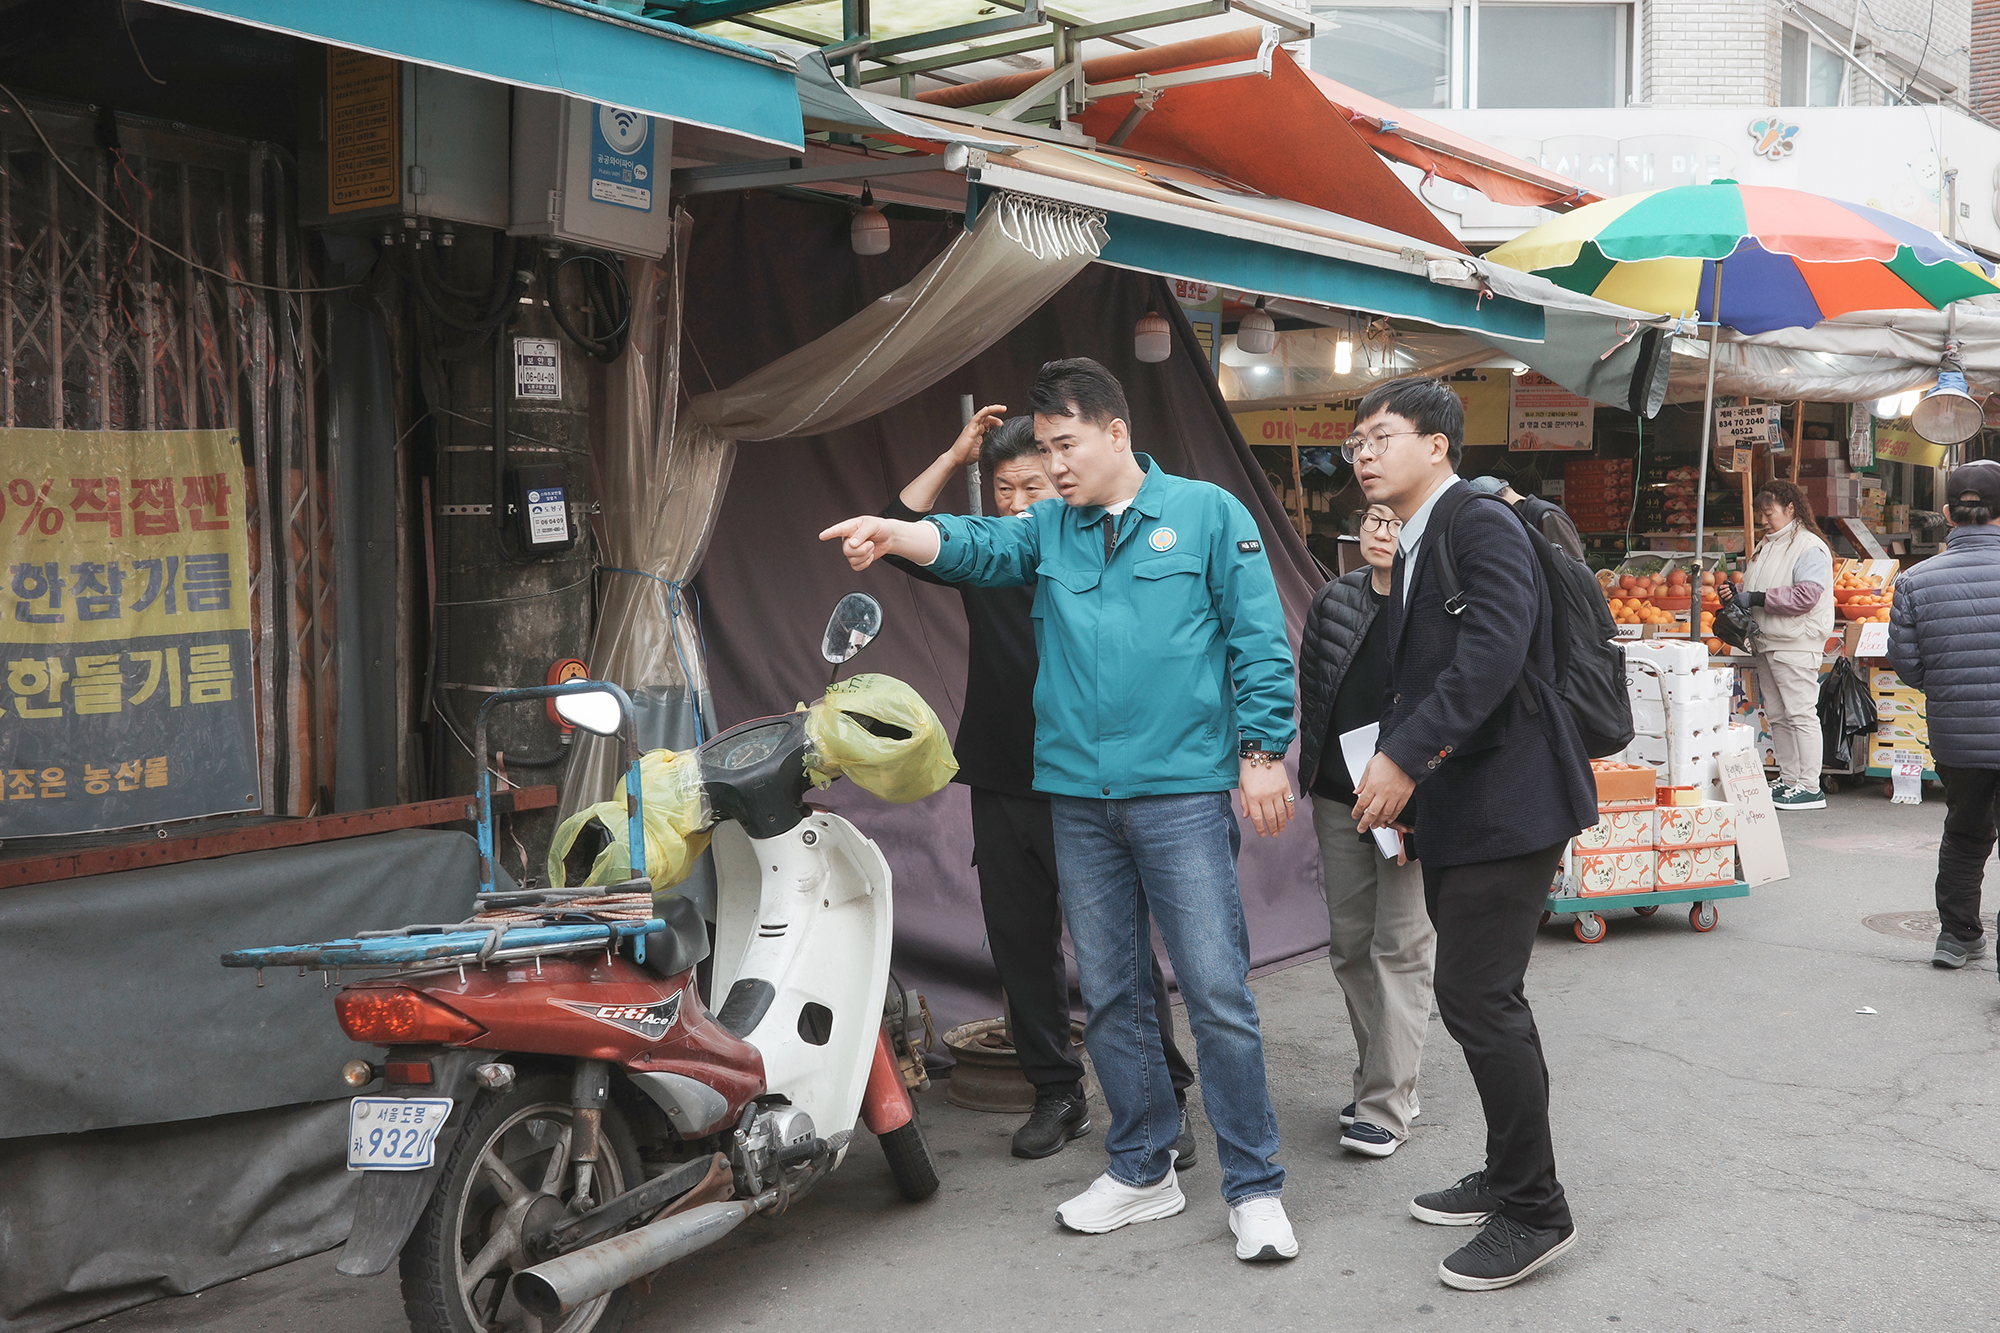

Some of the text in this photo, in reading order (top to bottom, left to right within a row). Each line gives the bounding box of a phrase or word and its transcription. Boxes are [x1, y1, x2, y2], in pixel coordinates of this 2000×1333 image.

[597, 153, 634, 170] 공공와이파이
[635, 168, 646, 176] Free
[1671, 153, 1721, 186] 마트
[525, 371, 555, 383] 06-04-09
[1719, 420, 1732, 428] 834
[1746, 417, 1765, 426] 2040
[1731, 427, 1754, 435] 40522
[1901, 765, 1921, 776] 42
[0, 756, 169, 801] 조은 농산물
[640, 1013, 669, 1025] Ace
[377, 1106, 426, 1124] 서울 도봉
[353, 1136, 363, 1156] 차
